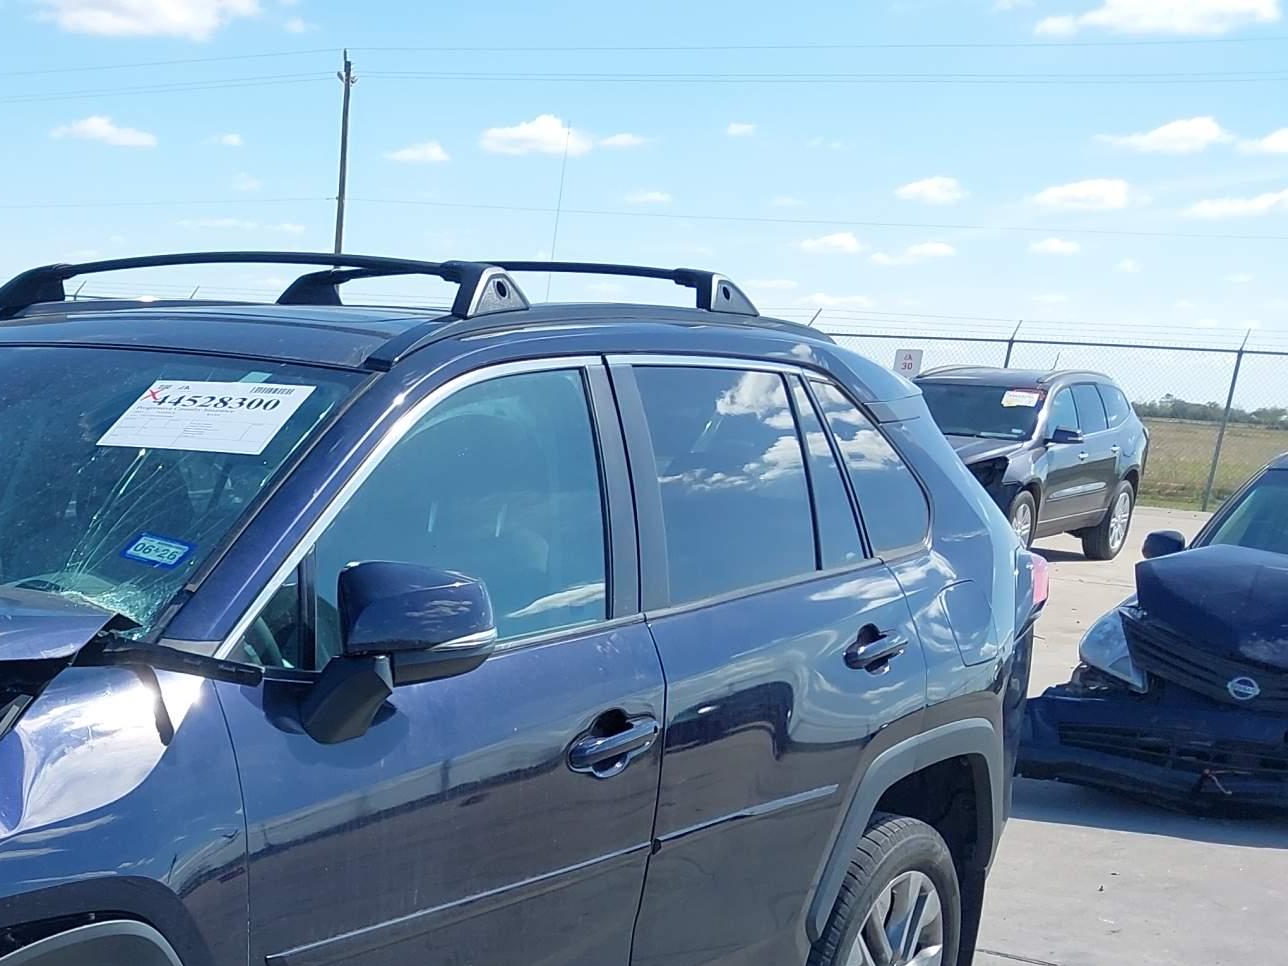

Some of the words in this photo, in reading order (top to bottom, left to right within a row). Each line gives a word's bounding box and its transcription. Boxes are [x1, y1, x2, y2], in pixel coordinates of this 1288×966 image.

[900, 362, 913, 371] 30
[152, 394, 281, 412] 44528300
[134, 542, 155, 555] 06
[157, 548, 179, 561] 26
